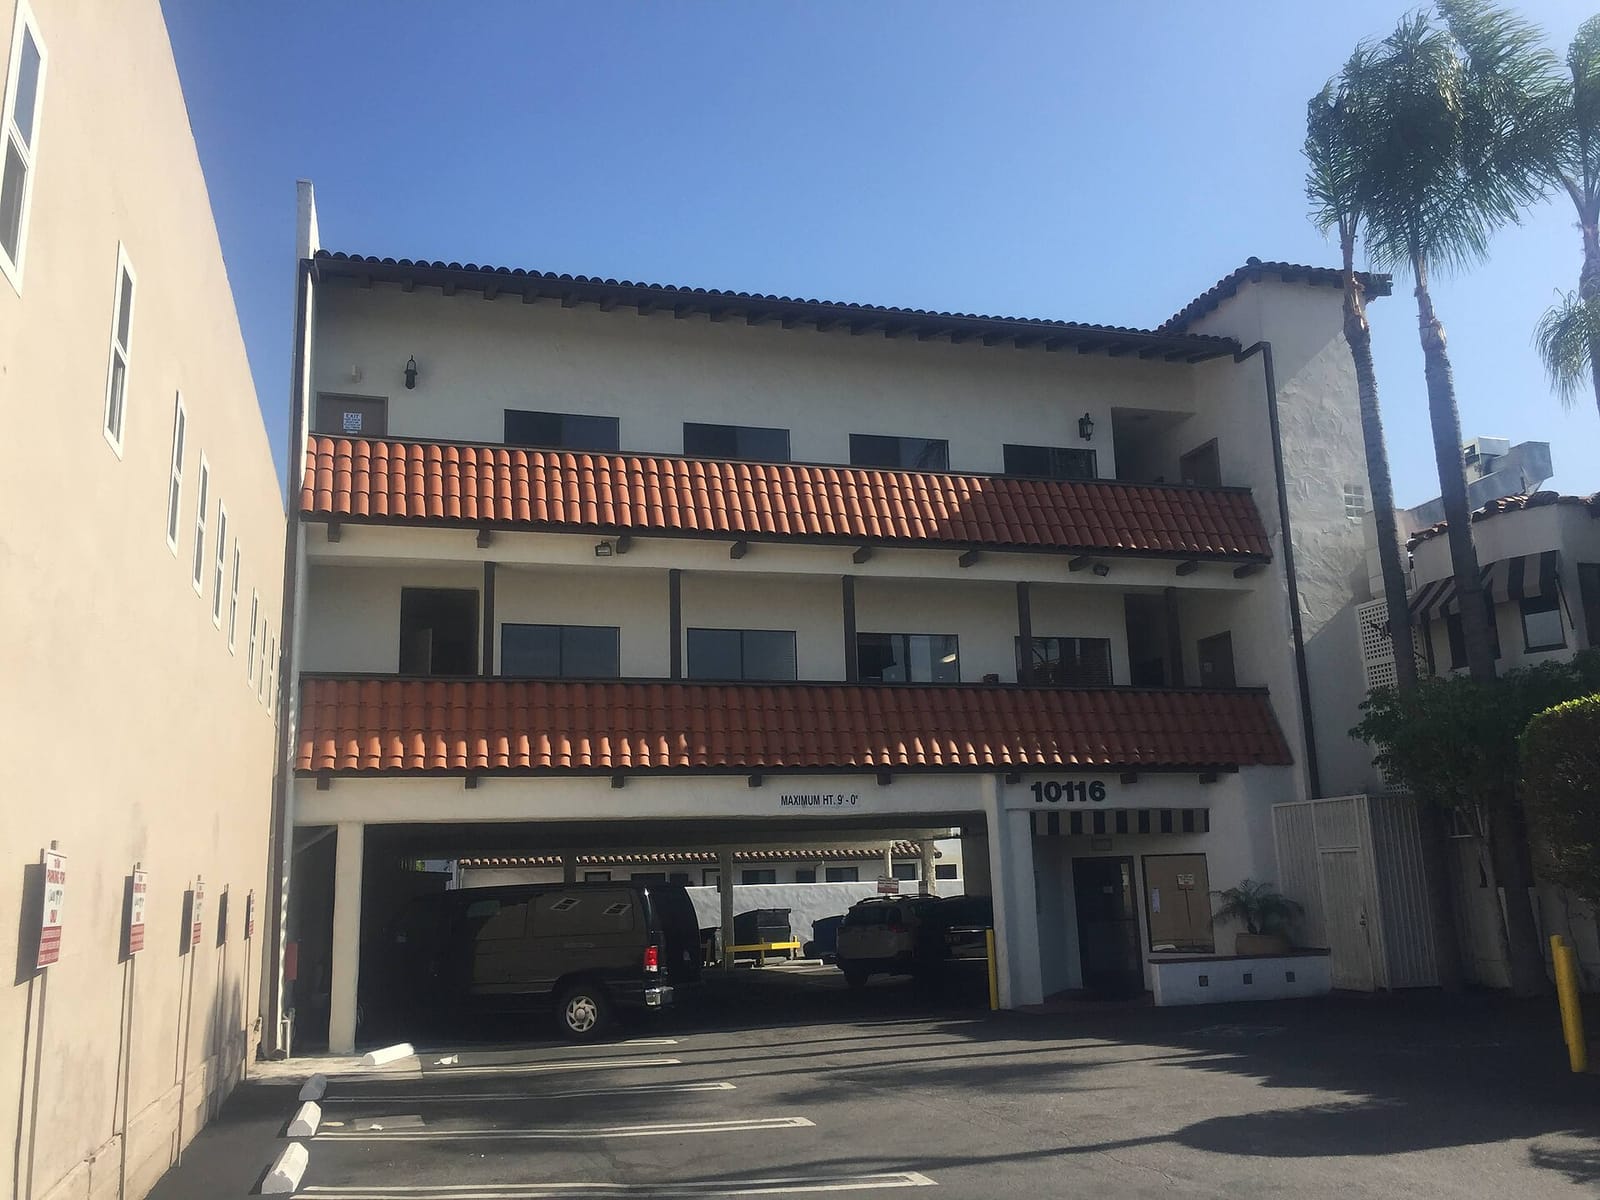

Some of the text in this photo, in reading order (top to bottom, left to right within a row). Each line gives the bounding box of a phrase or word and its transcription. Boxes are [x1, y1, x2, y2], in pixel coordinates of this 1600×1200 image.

[1031, 781, 1105, 802] 10116
[781, 794, 820, 806] MAXIMUM
[823, 794, 836, 805] HT.
